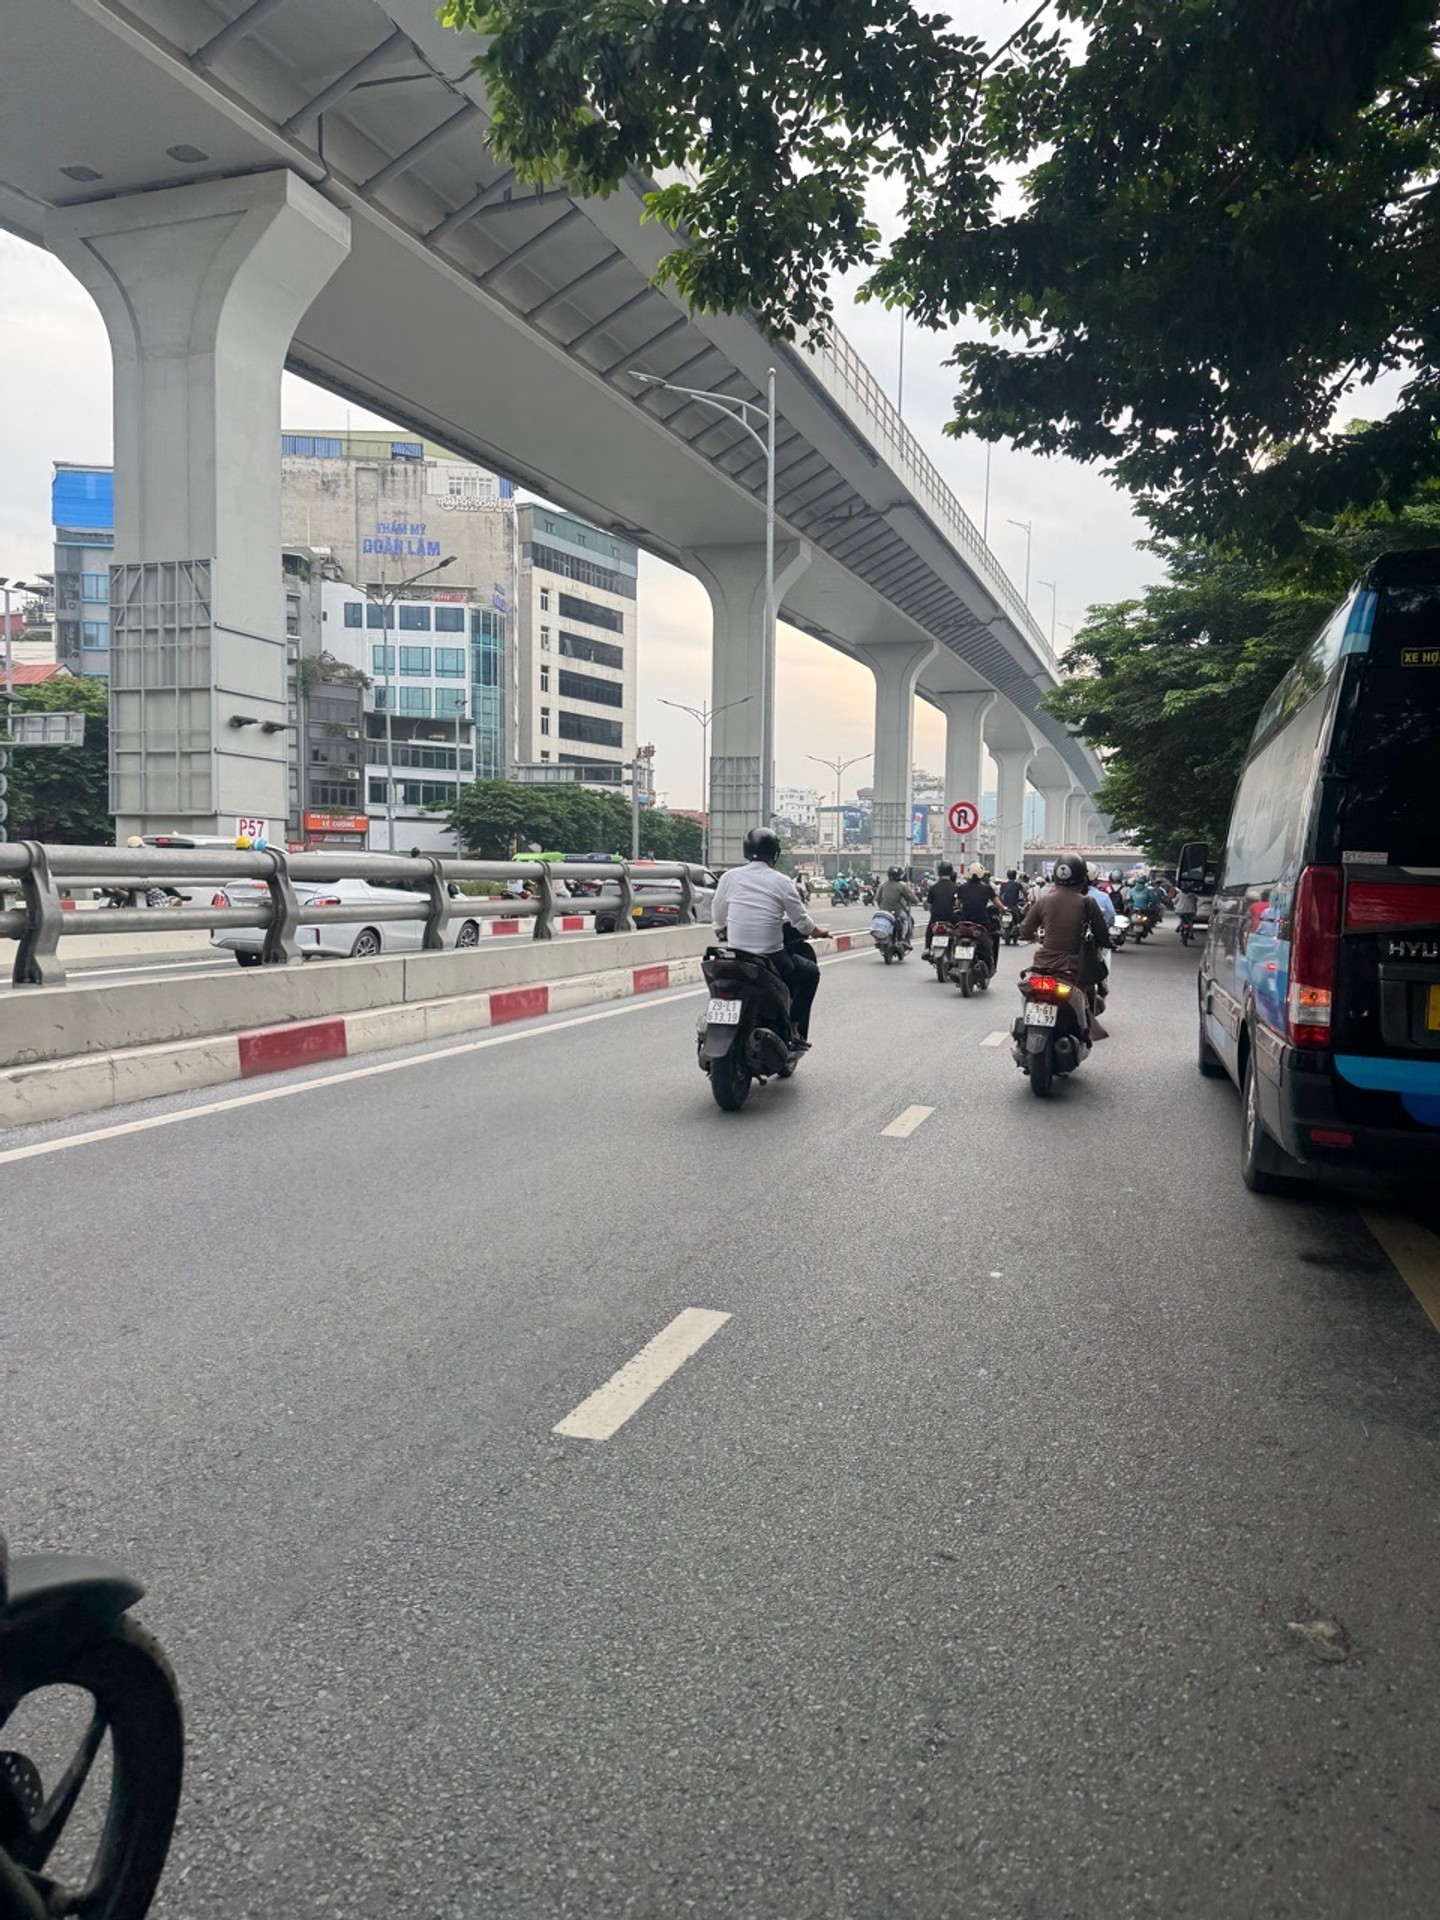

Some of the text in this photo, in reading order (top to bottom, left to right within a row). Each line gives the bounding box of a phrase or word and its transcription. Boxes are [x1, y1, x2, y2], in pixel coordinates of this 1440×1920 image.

[1404, 650, 1440, 666] XE HỢ
[239, 819, 265, 837] P57
